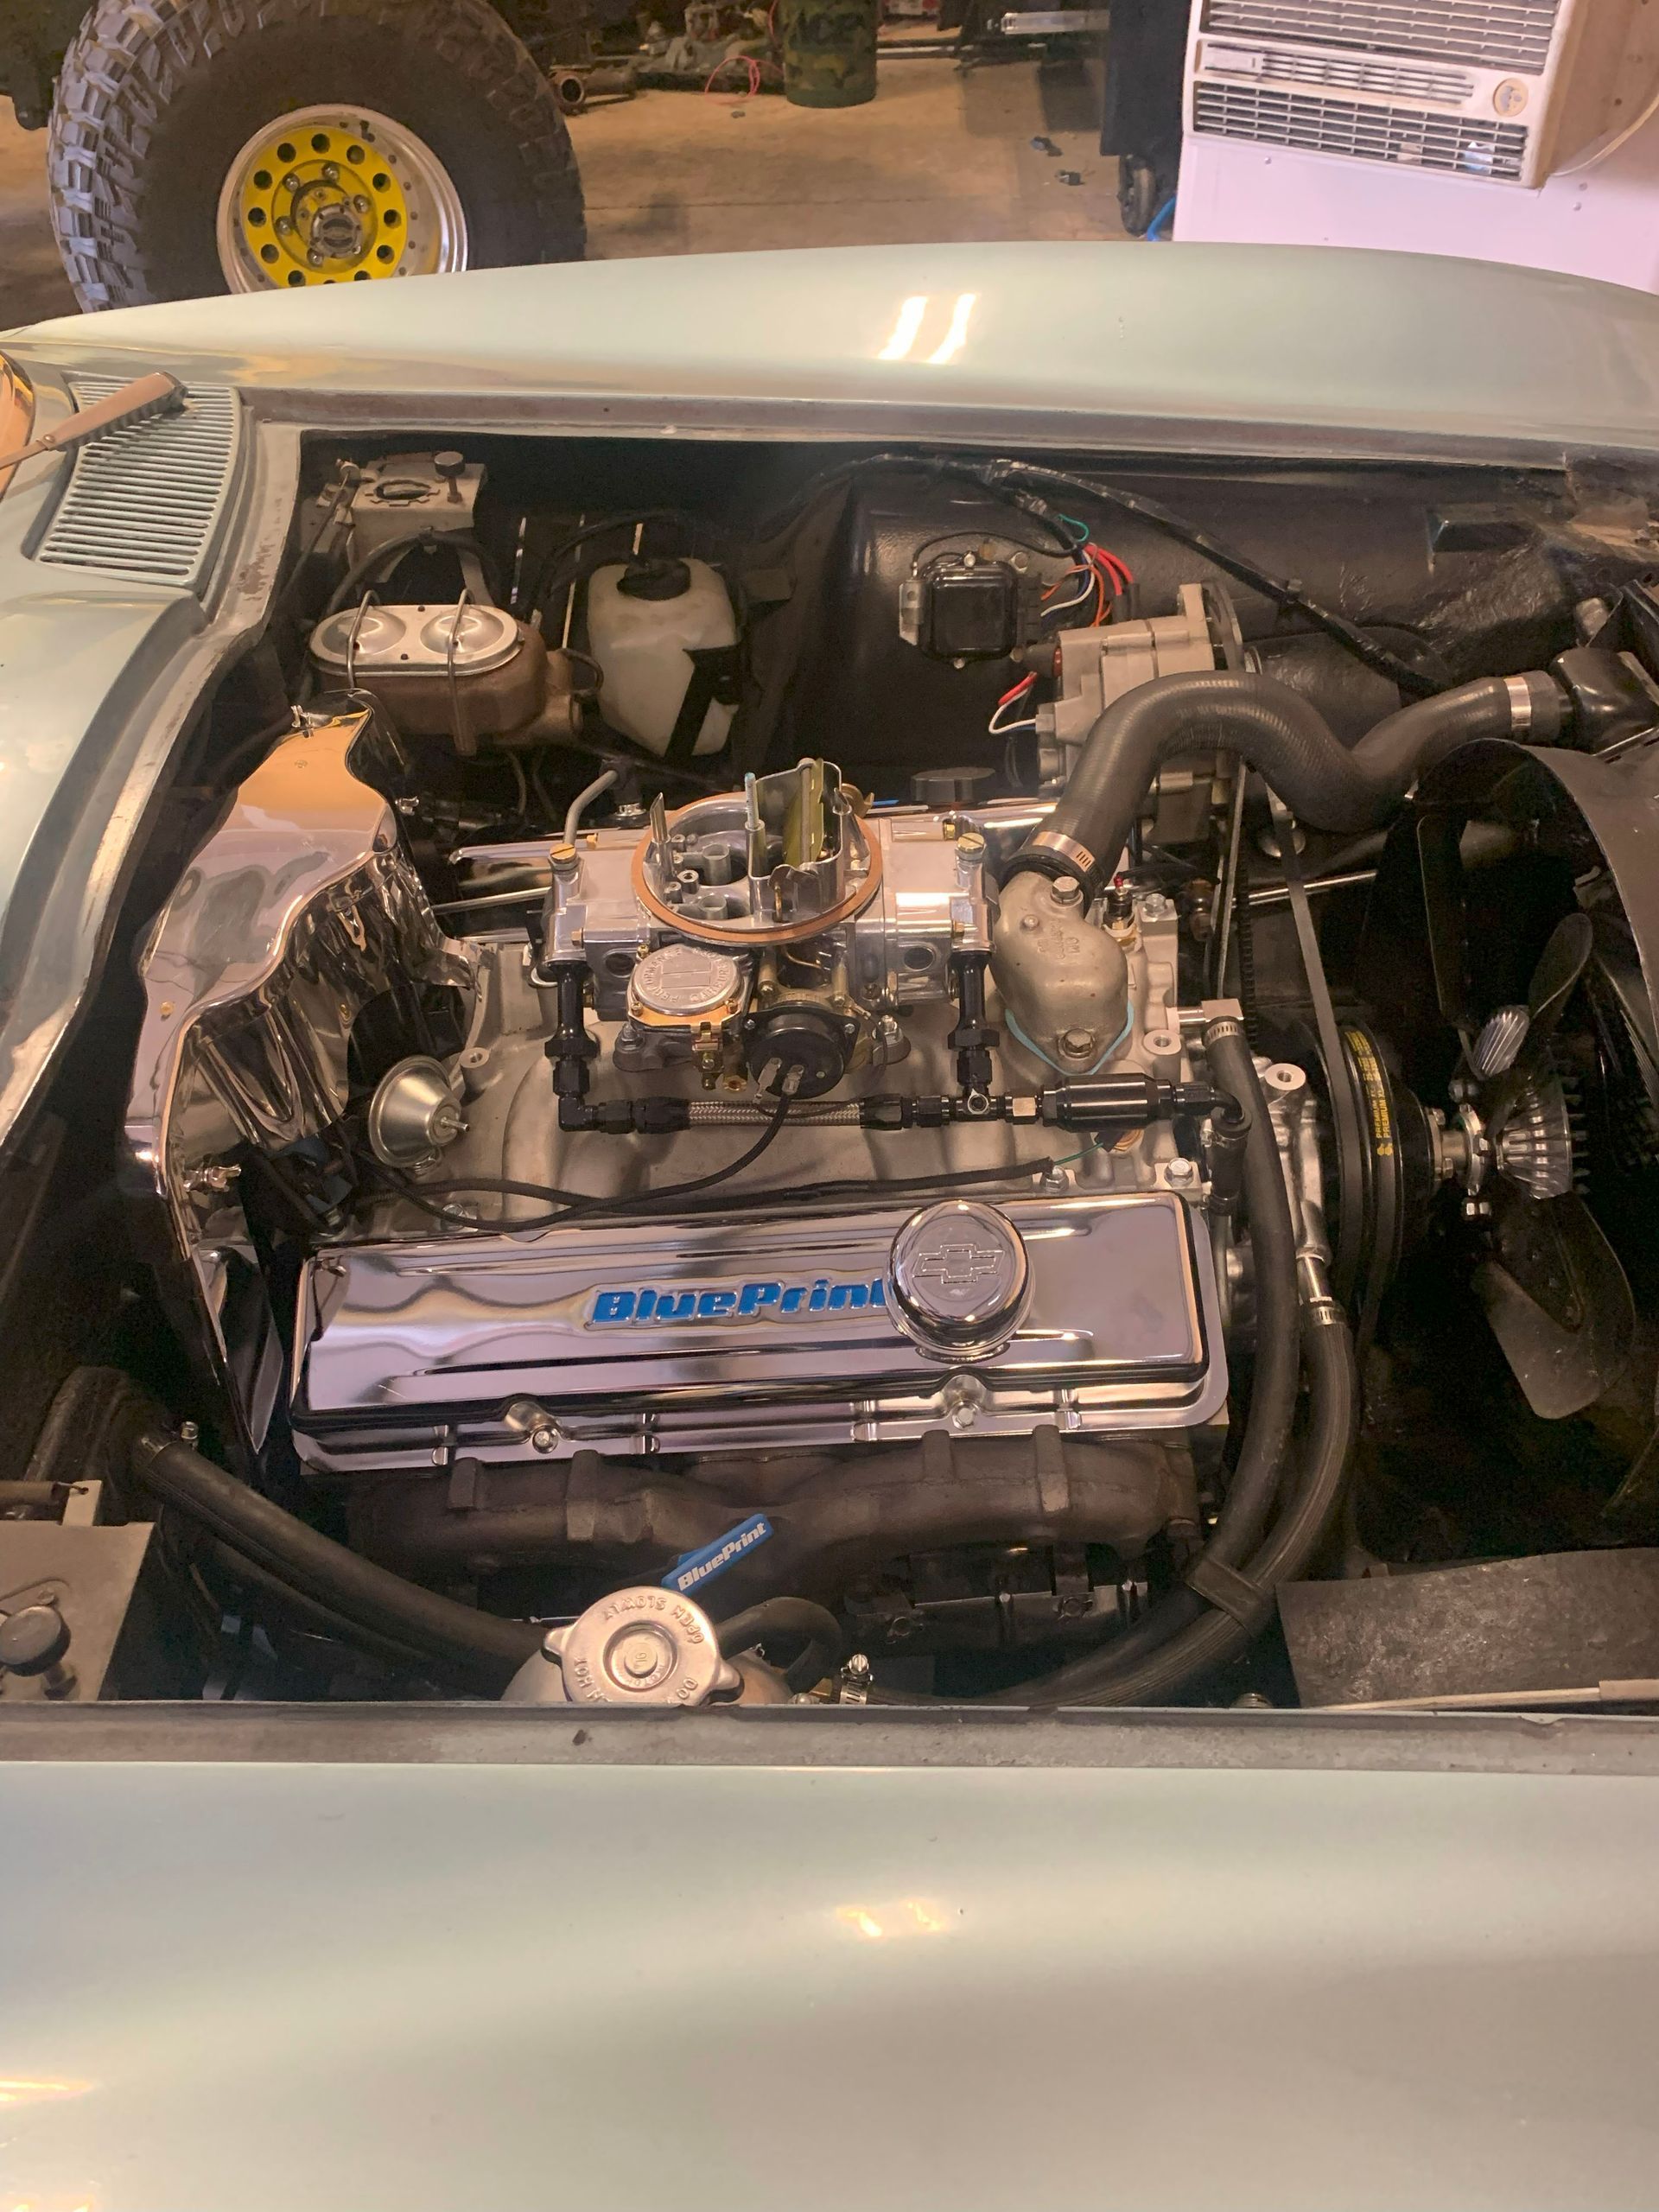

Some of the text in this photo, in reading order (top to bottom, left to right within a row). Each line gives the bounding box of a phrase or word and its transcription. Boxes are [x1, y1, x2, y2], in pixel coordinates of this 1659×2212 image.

[1372, 1100, 1382, 1138] PREMIUM
[1379, 1099, 1391, 1138] PREMIUM
[677, 1522, 767, 1592] BluePrint
[670, 1605, 705, 1644] OPEN
[676, 1677, 699, 1700] DO
